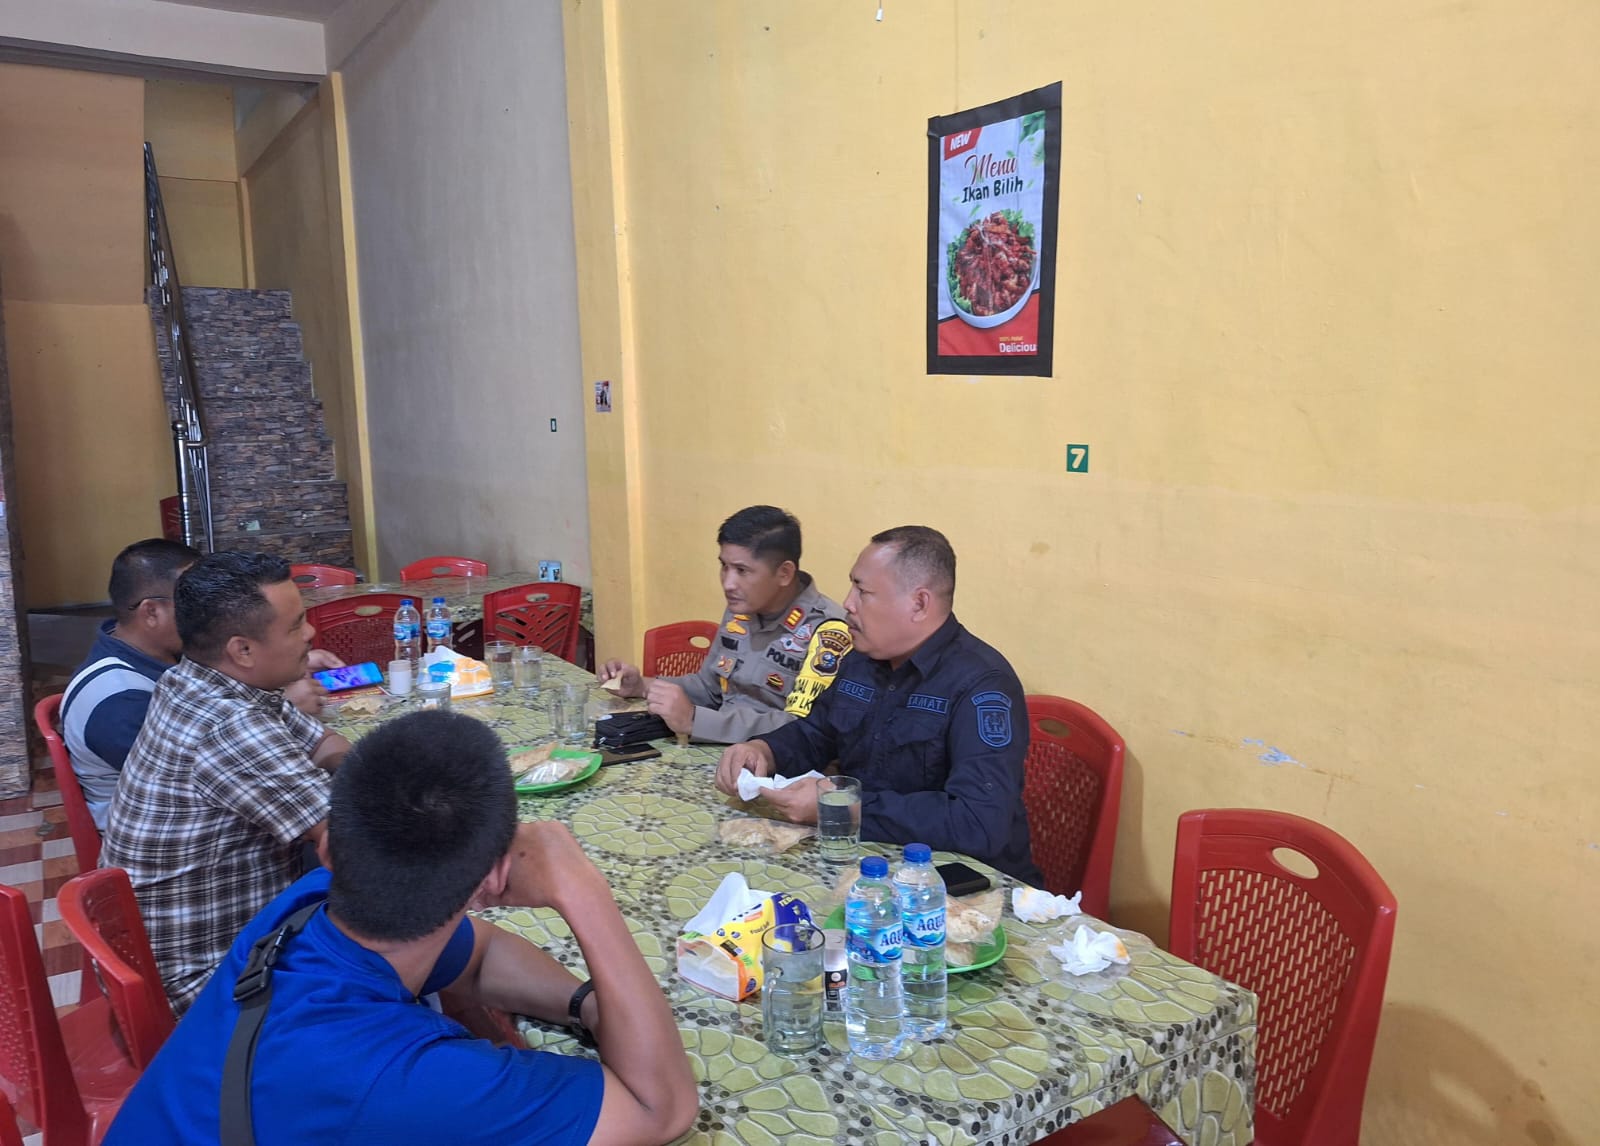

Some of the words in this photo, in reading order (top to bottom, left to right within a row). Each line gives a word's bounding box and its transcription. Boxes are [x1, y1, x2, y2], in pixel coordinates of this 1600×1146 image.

[950, 130, 972, 152] NEW
[964, 153, 1017, 186] Menu
[961, 184, 990, 204] Ikan
[993, 176, 1024, 198] Bilih
[1070, 447, 1086, 469] 7
[916, 911, 945, 931] AQU
